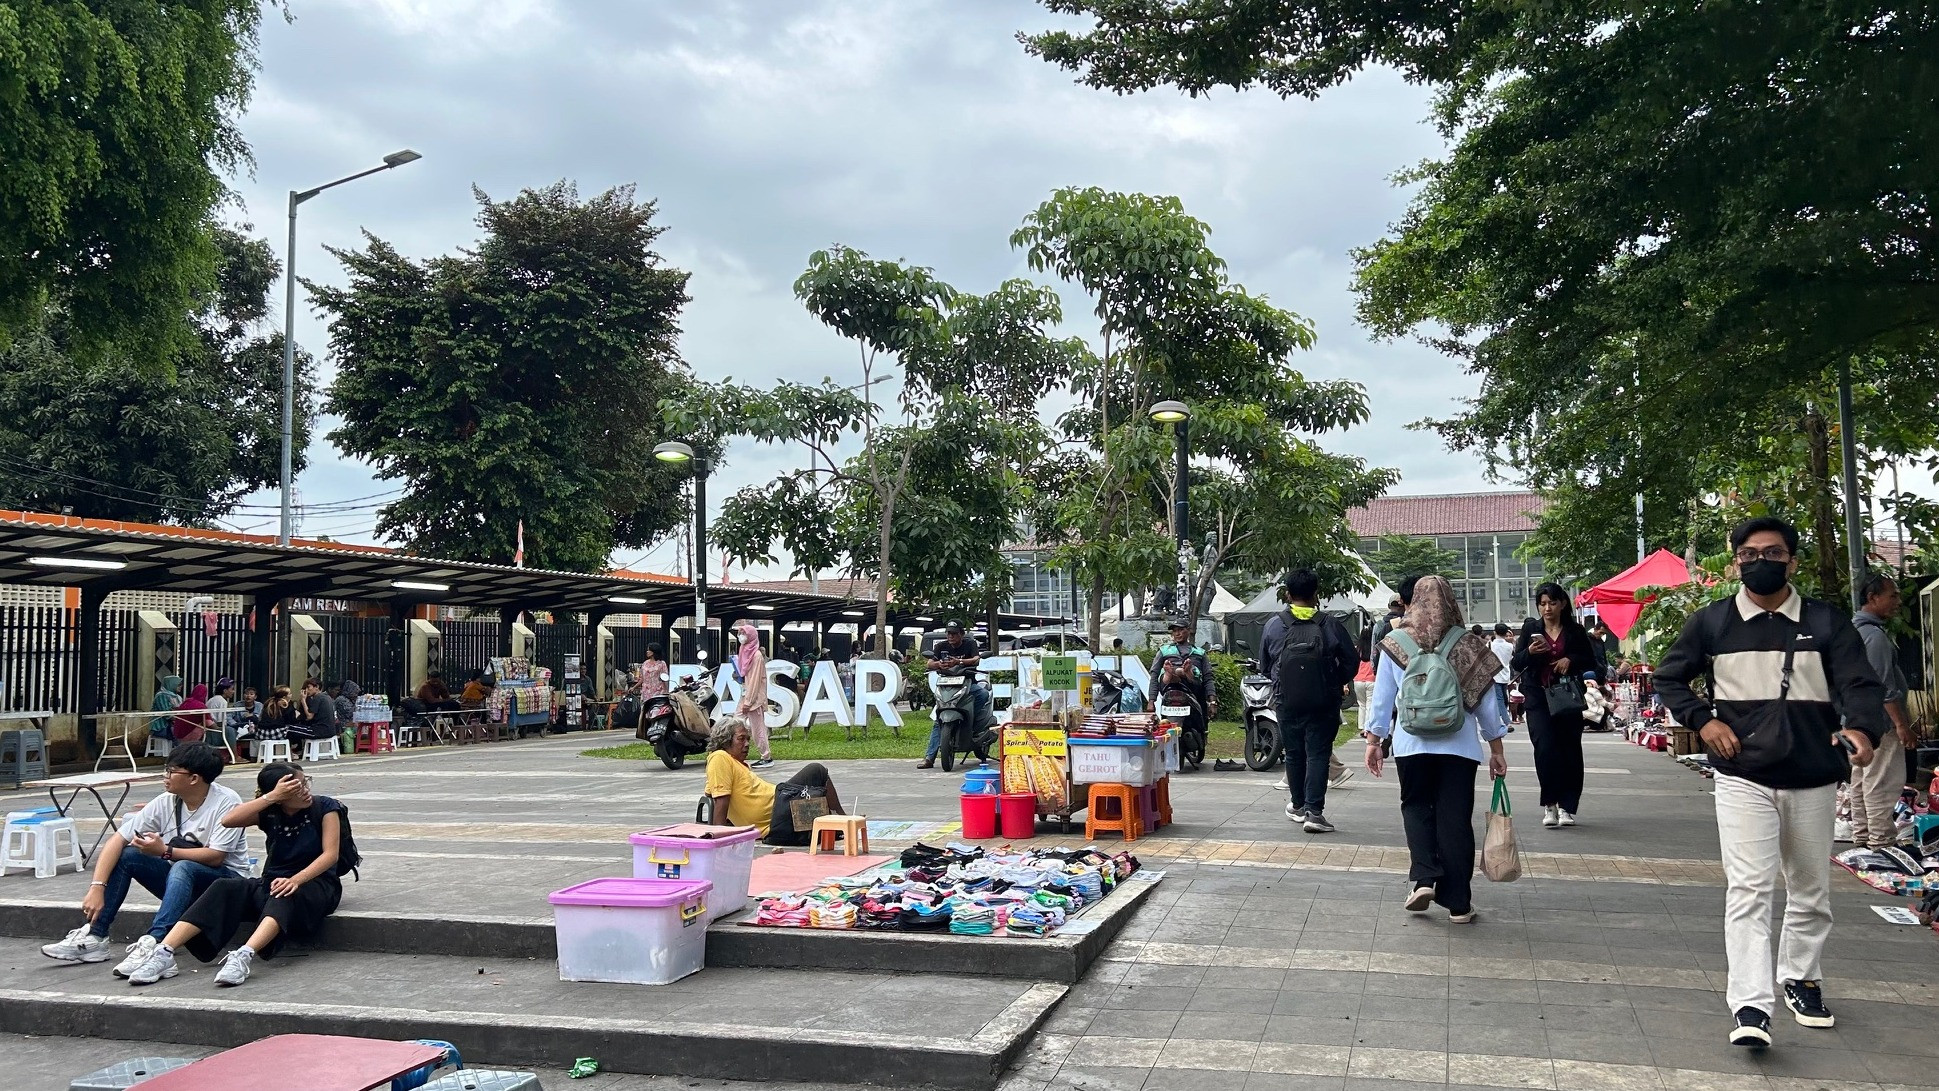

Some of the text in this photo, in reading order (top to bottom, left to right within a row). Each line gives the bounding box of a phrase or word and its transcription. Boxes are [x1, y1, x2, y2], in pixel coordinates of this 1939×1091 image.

[1006, 739, 1029, 747] Spiral
[1084, 752, 1111, 762] TAHU
[1078, 764, 1118, 774] GEJROT
